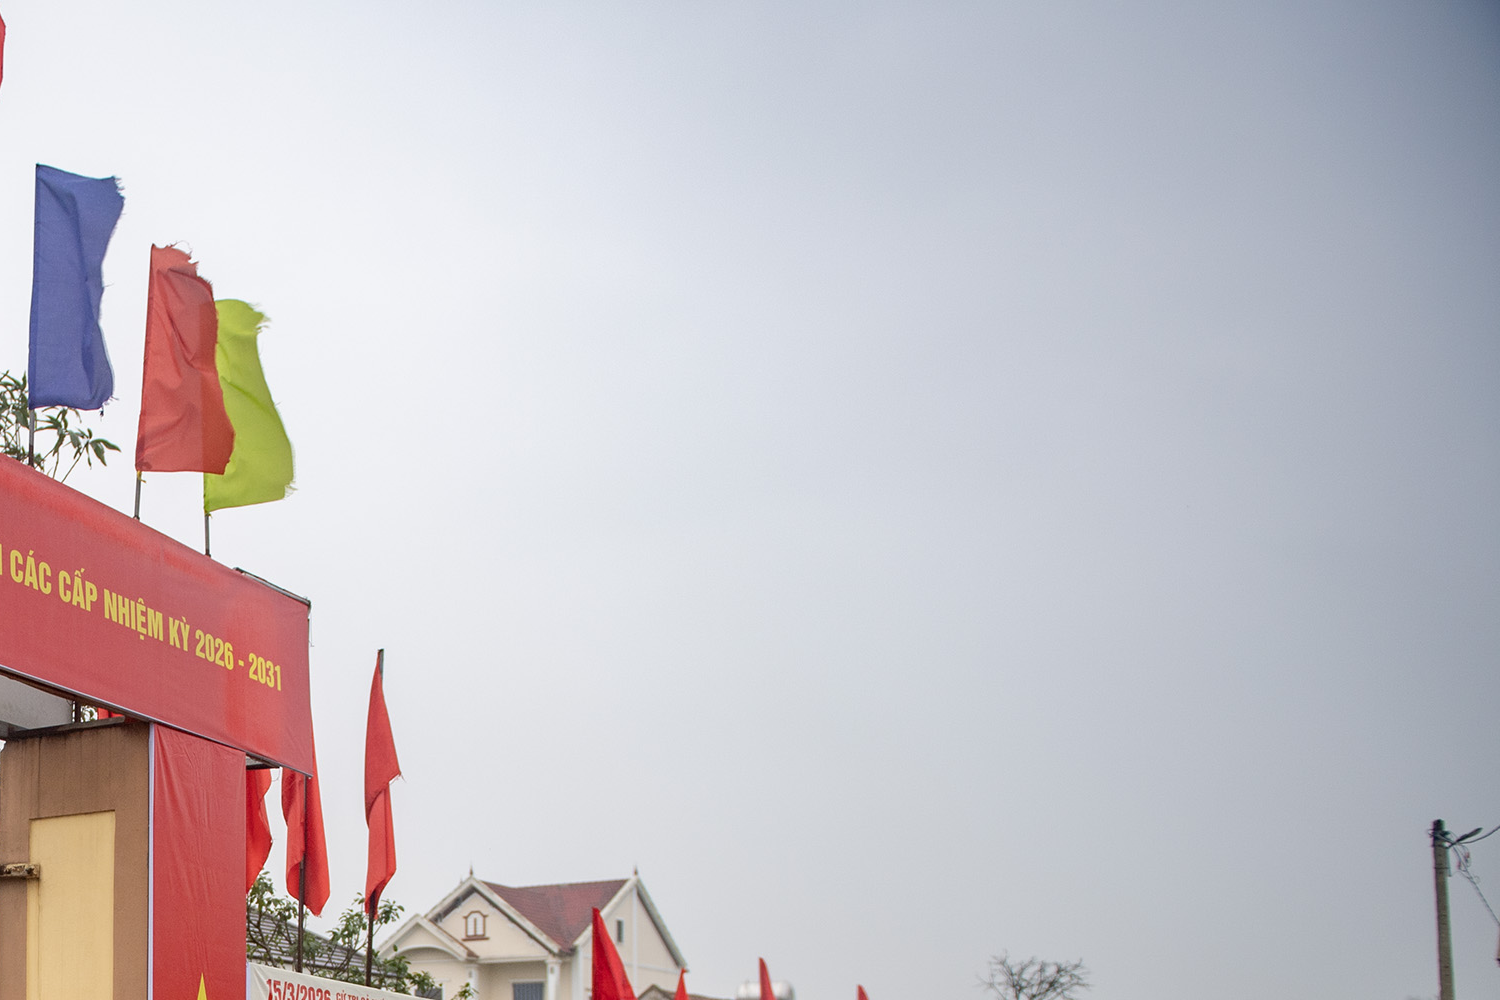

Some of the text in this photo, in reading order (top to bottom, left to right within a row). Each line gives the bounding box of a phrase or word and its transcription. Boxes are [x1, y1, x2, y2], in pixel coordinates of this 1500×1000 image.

[10, 550, 52, 595] CÁC
[58, 568, 98, 612] CẤP
[104, 591, 163, 641] NHIỆM
[169, 616, 190, 651] KỲ
[195, 631, 233, 670] 2026
[249, 653, 281, 691] 2031
